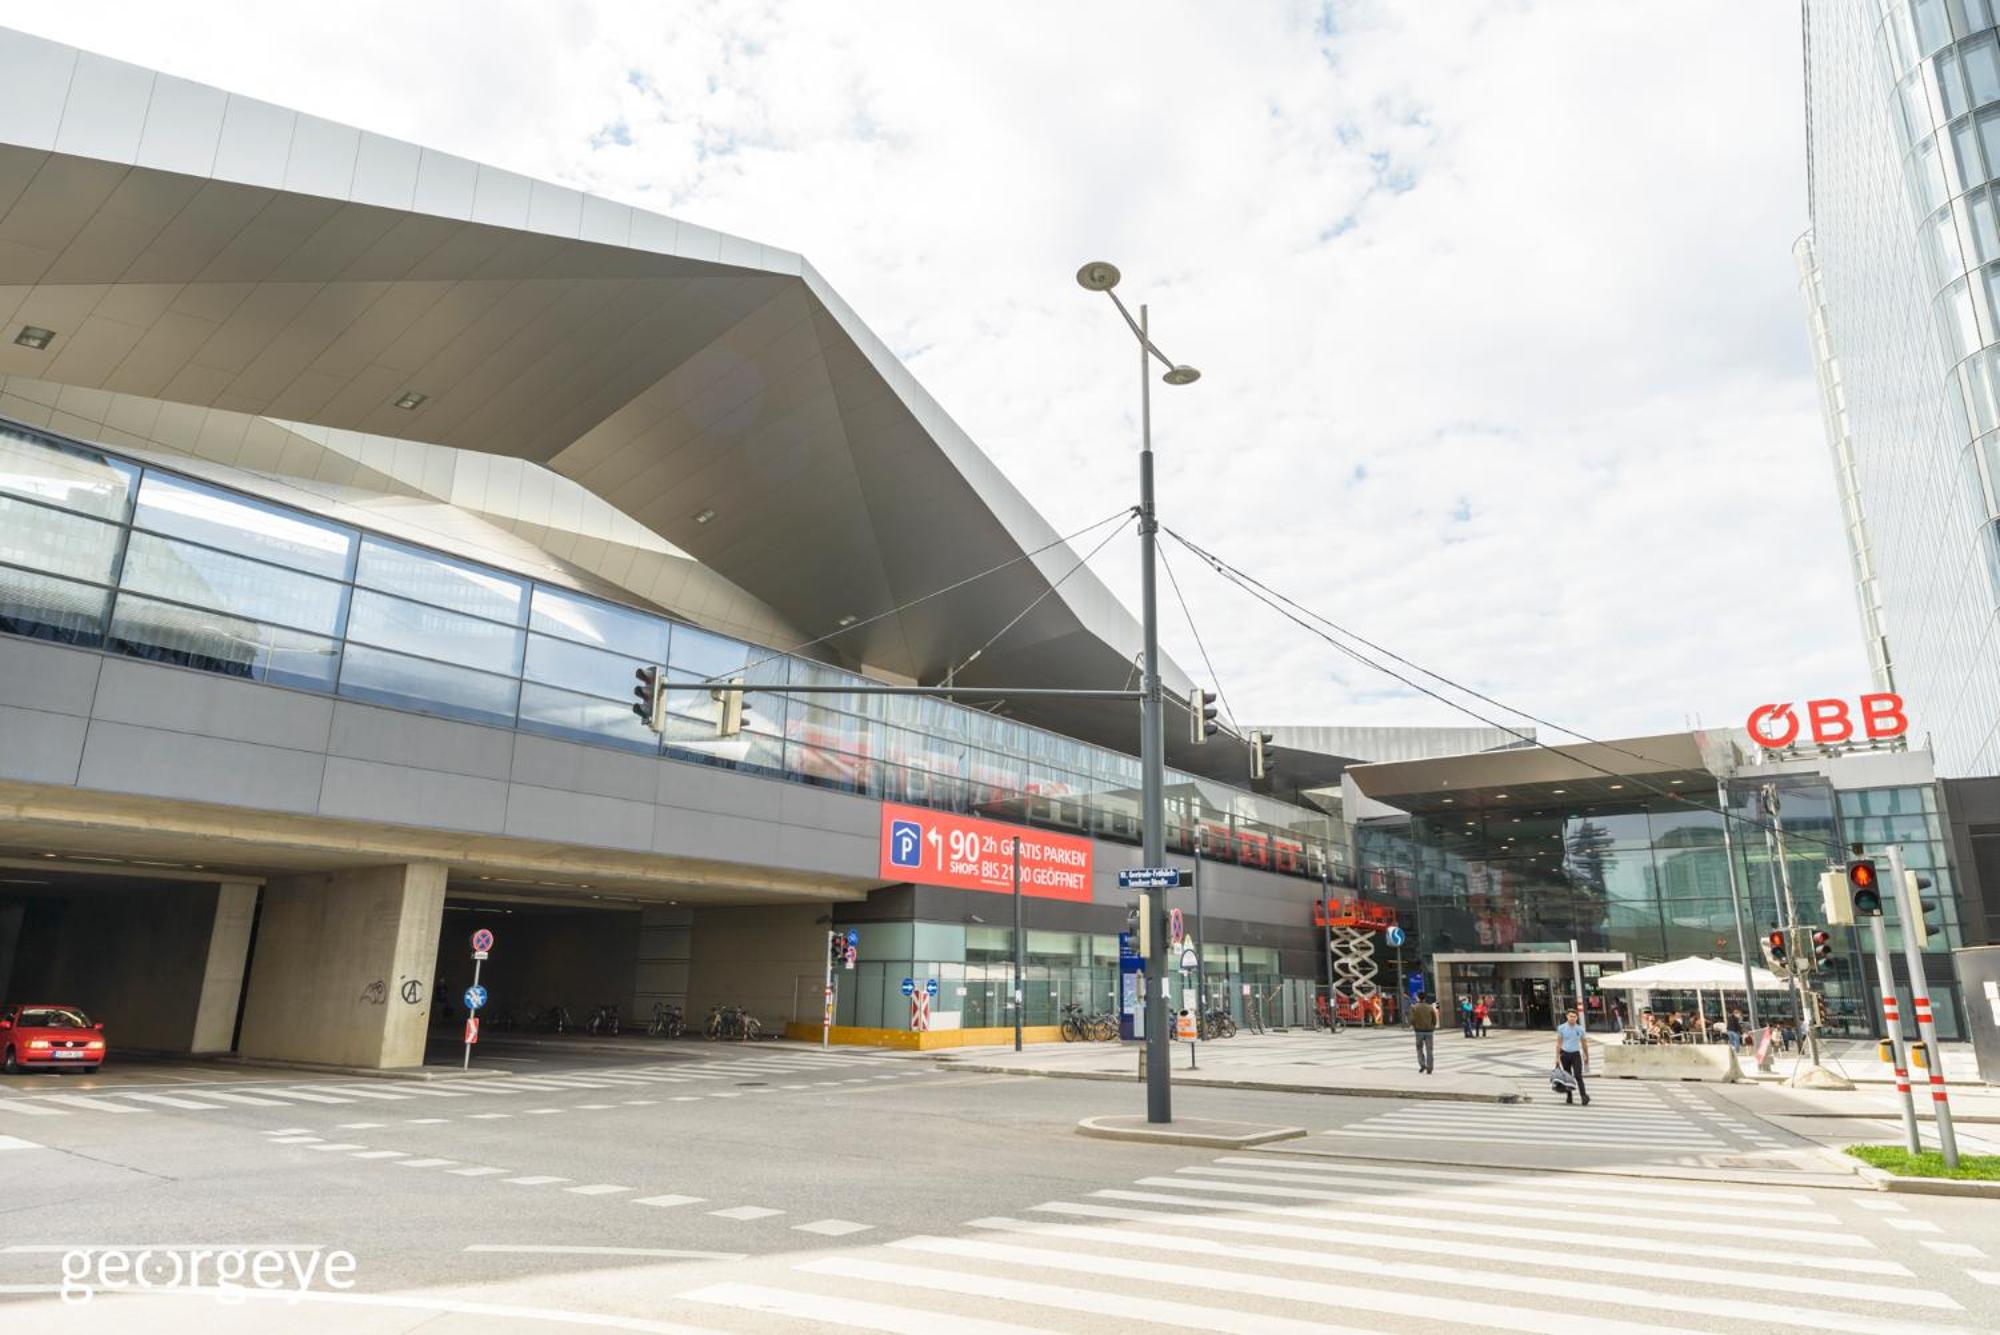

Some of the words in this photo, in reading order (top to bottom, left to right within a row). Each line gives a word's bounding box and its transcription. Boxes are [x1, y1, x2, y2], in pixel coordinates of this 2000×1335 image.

[1747, 693, 1908, 748] ÖBB
[950, 829, 979, 862] 90
[982, 836, 998, 854] 2h
[950, 861, 980, 876] SHOPS
[982, 860, 1000, 880] BIS
[1033, 867, 1086, 889] GEÖFFNET
